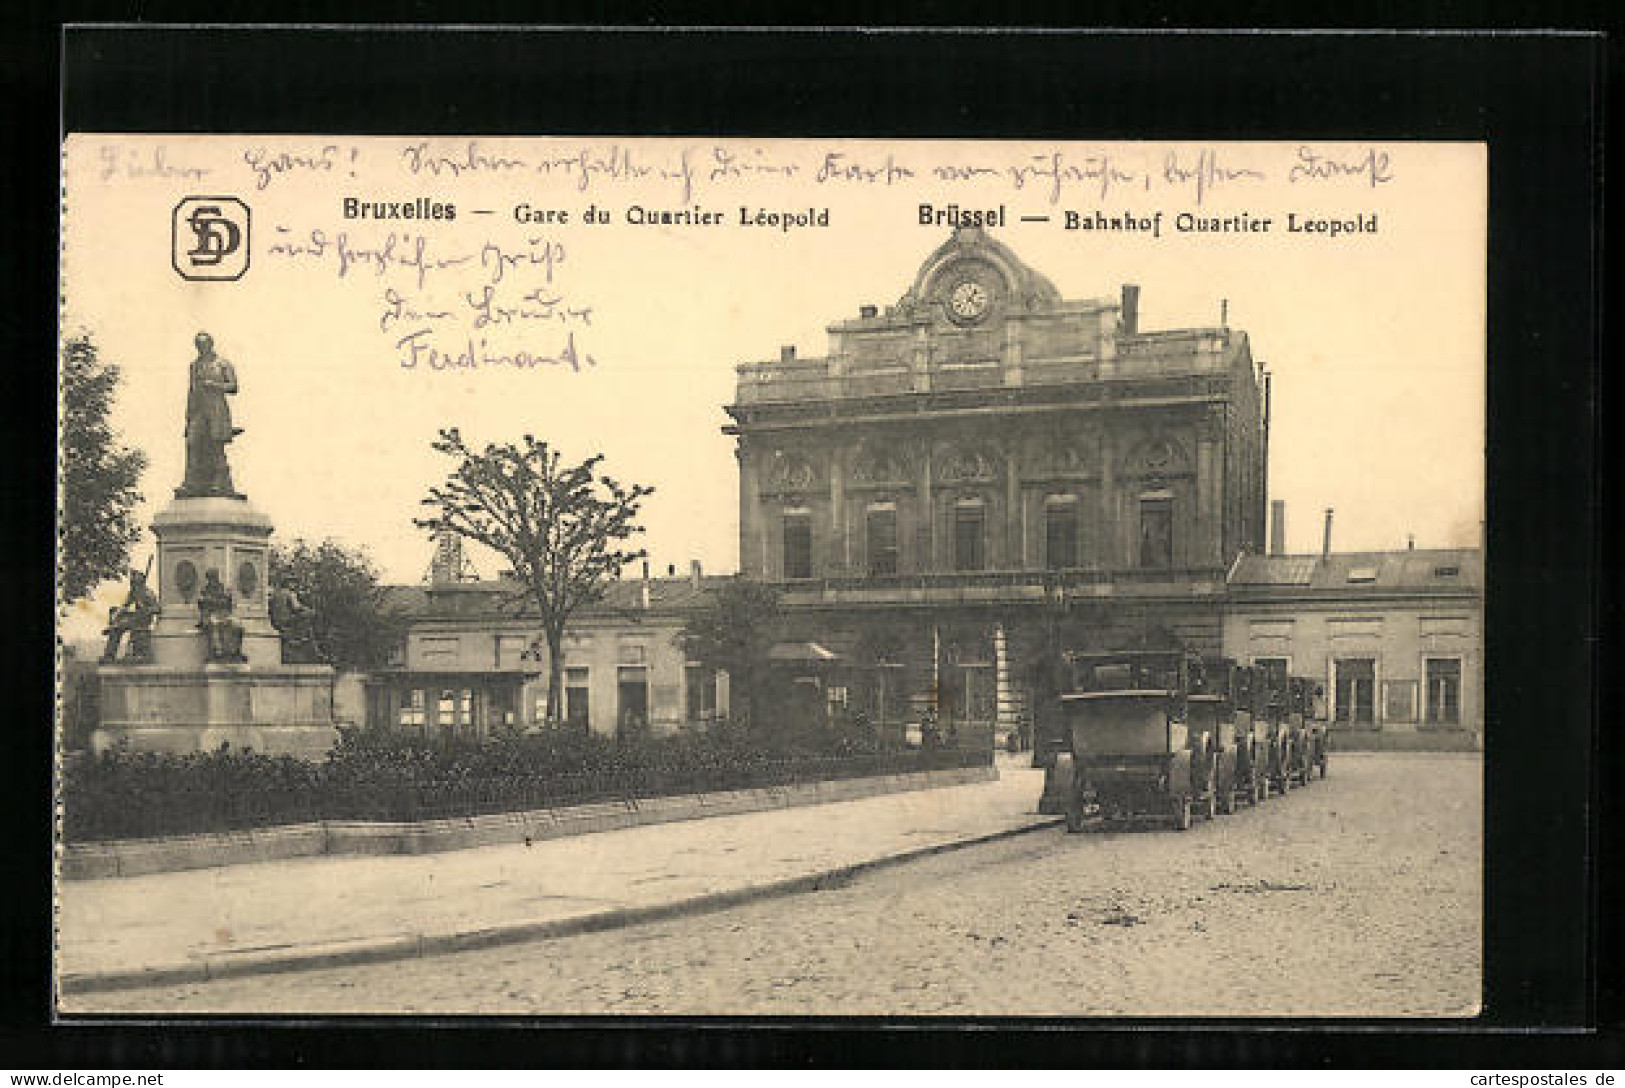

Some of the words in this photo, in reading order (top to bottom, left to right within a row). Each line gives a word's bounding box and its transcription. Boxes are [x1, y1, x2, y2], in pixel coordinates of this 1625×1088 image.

[343, 197, 457, 221] Bruxelles
[514, 204, 569, 225] Gare
[583, 204, 611, 225] du
[626, 206, 725, 226] Quartier
[739, 204, 831, 231] Léopold
[918, 204, 1006, 228] Brüssel
[1064, 210, 1162, 238] Bahnhof
[1176, 212, 1272, 234] Quartier
[1287, 213, 1379, 238] Leopold
